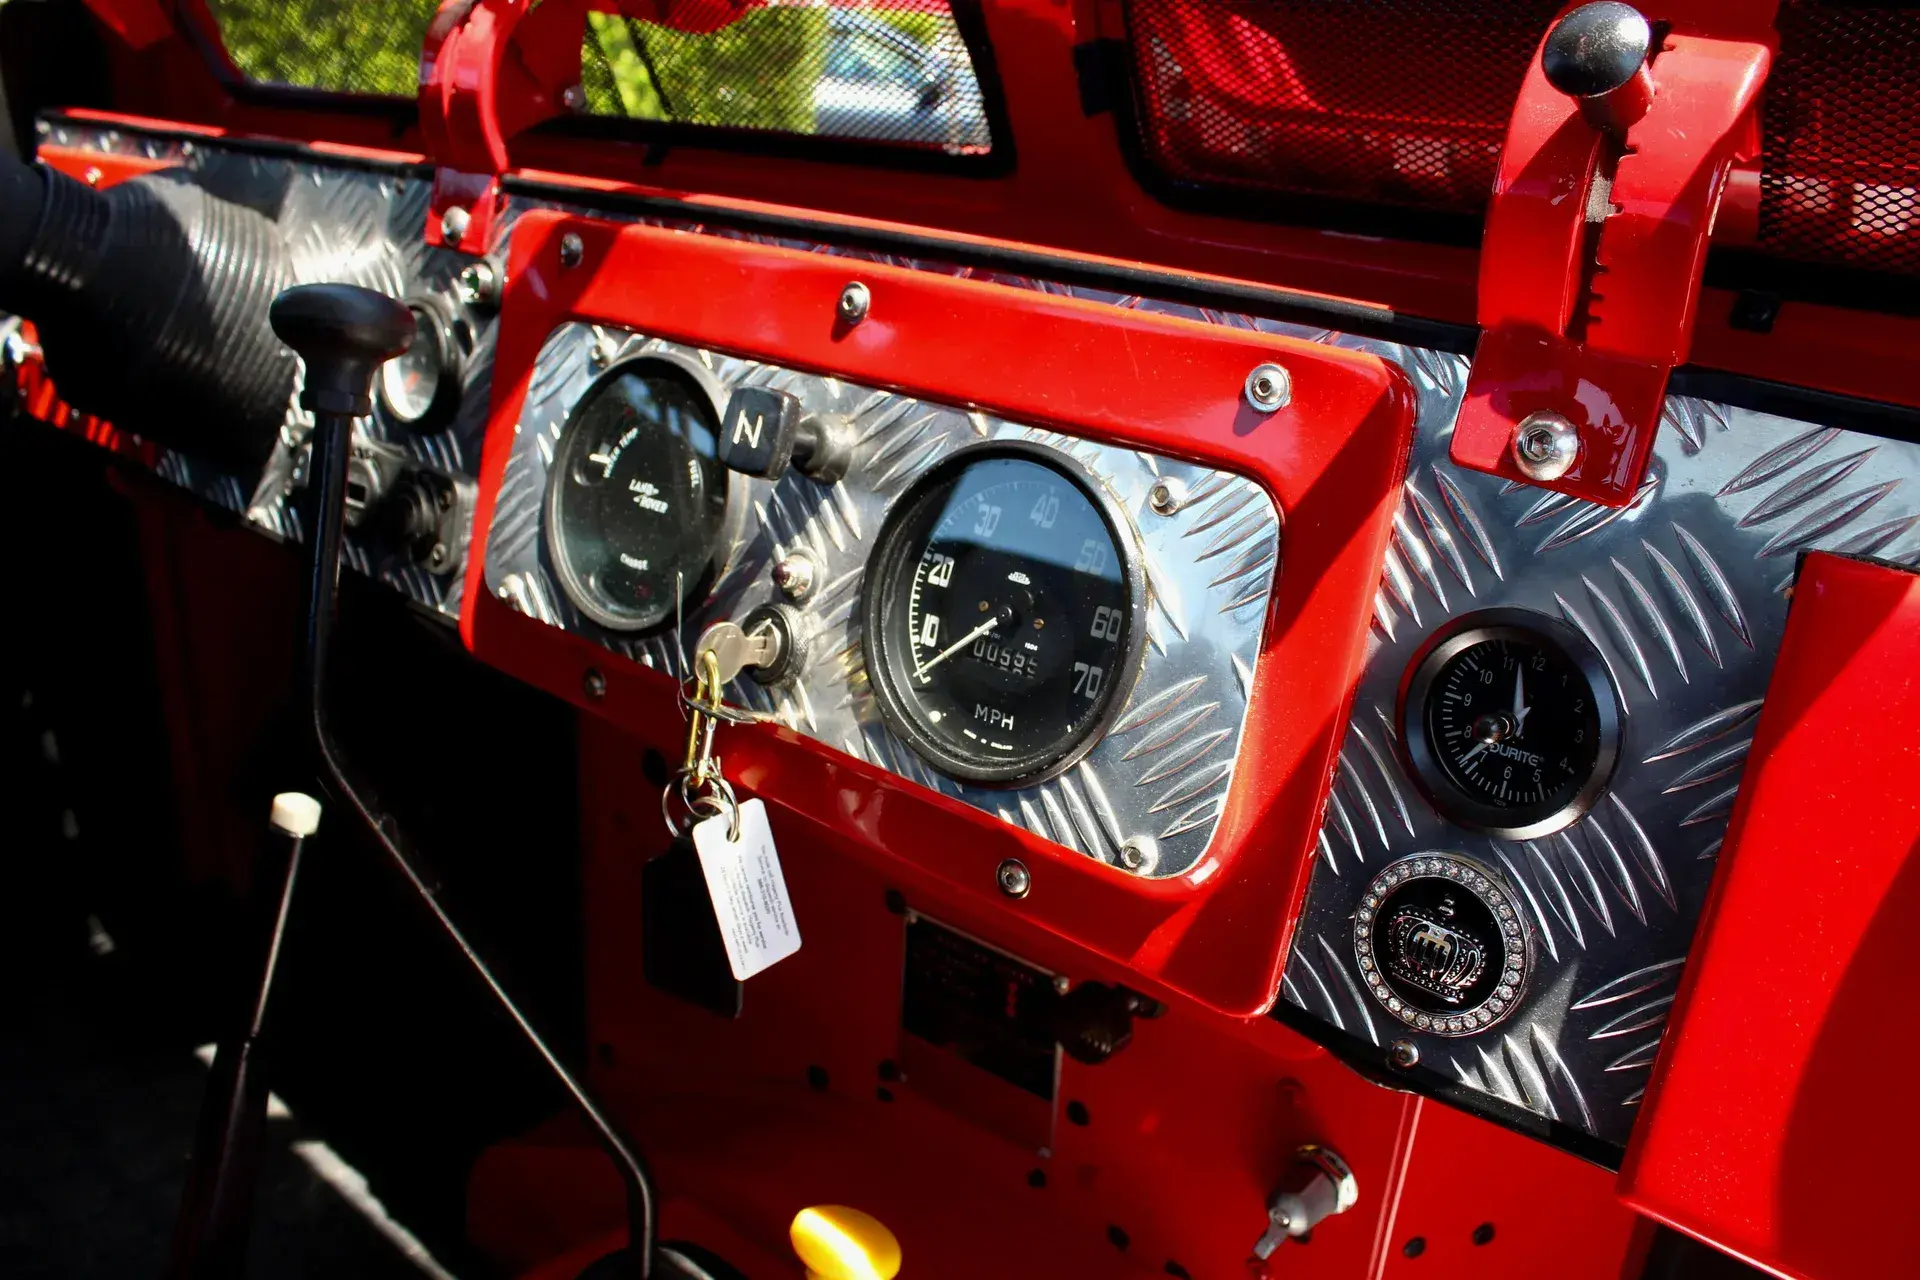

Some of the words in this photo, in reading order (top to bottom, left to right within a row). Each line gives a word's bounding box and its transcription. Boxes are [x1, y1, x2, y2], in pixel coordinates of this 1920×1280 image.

[732, 409, 764, 449] N
[1030, 495, 1060, 529] 40
[974, 504, 1001, 538] 30
[1074, 538, 1107, 576] 50
[927, 554, 955, 588] 20
[920, 613, 940, 648] 10
[1090, 605, 1123, 643] 60
[1502, 656, 1515, 671] 11
[1531, 656, 1546, 672] 12
[1073, 662, 1103, 700] 70
[1478, 668, 1493, 685] 10
[1561, 674, 1568, 688] 1
[1463, 693, 1473, 707] 9
[1573, 699, 1585, 714] 2
[974, 703, 1014, 731] MPH
[1463, 725, 1473, 739] 8
[1573, 729, 1584, 744] 3
[1479, 750, 1489, 764] 7
[1558, 755, 1569, 771] 4
[1503, 765, 1513, 780] 6
[1532, 768, 1542, 783] 5
